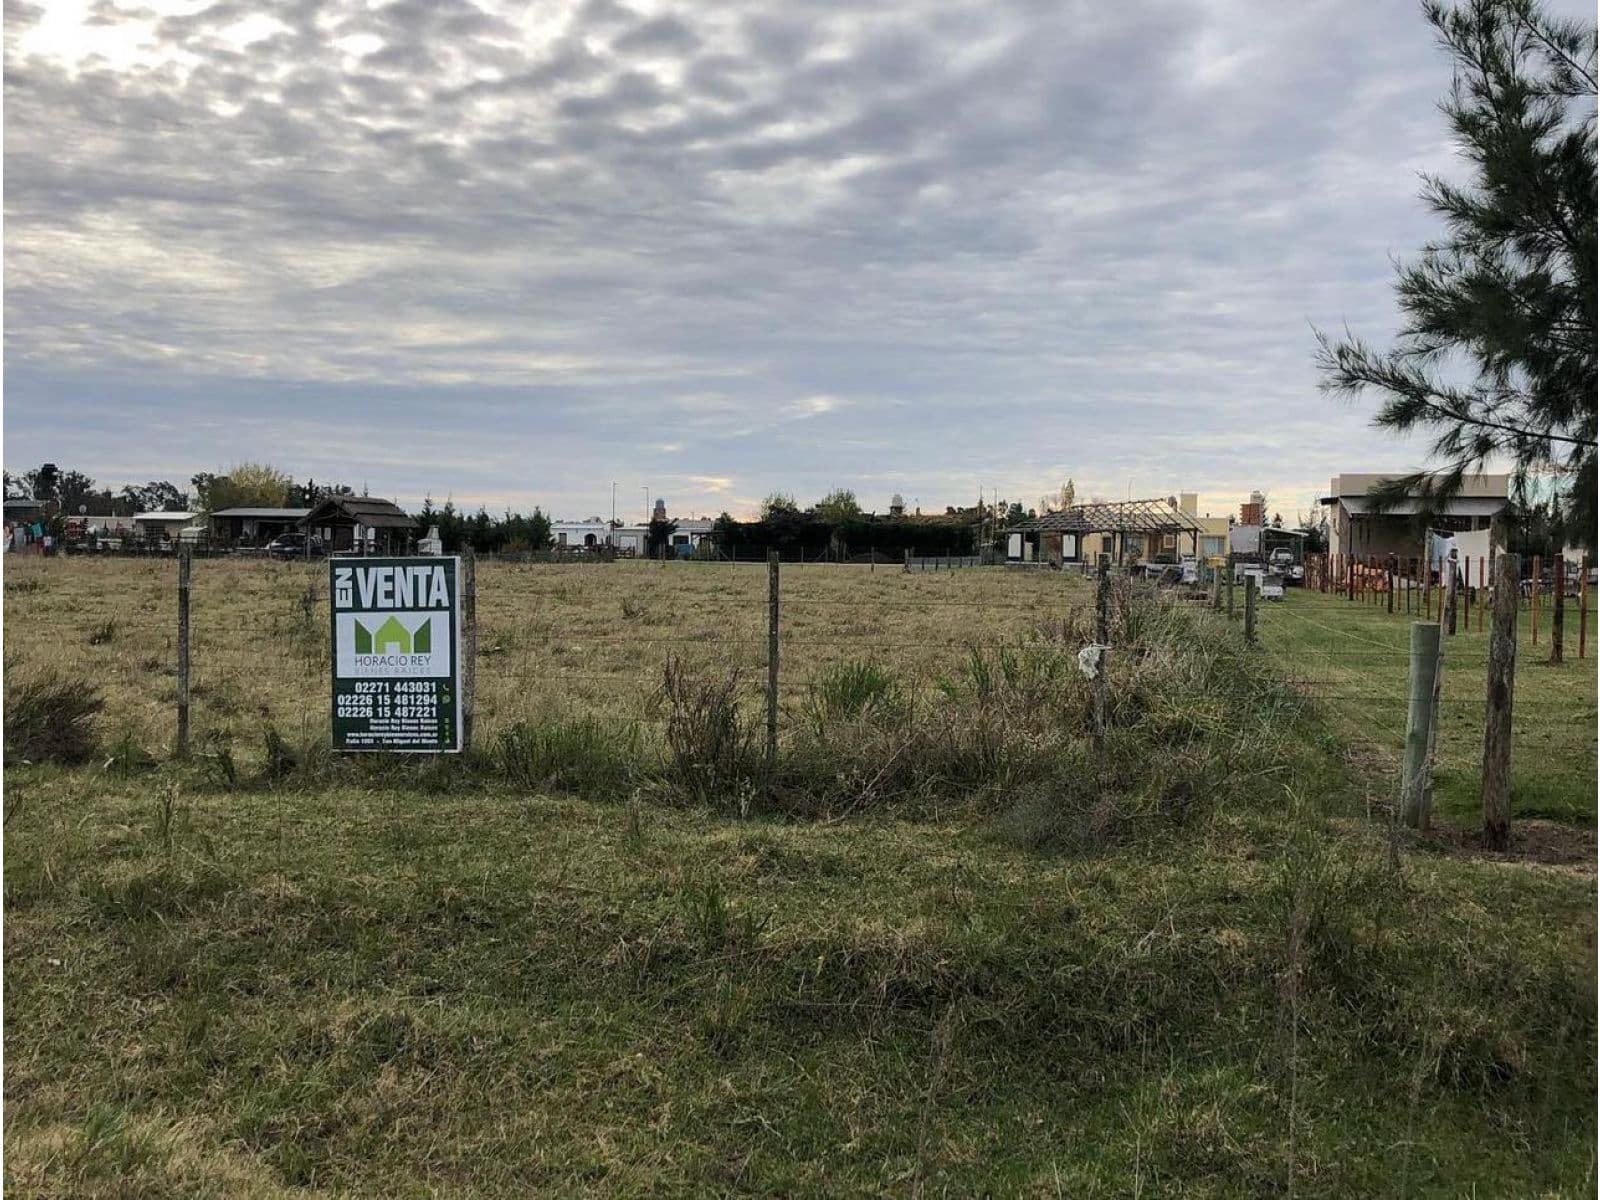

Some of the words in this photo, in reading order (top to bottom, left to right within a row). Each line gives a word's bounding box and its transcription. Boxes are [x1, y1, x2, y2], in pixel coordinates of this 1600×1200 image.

[336, 567, 353, 608] EN
[355, 566, 450, 608] VENTA
[355, 656, 408, 666] HORACIO
[411, 656, 432, 666] REY
[355, 682, 390, 693] 02271
[394, 682, 437, 693] 443031
[337, 694, 373, 706] 02226
[377, 694, 391, 706] 15
[394, 694, 438, 706] 481294
[337, 706, 373, 718] 02226
[377, 706, 391, 718] 15
[394, 706, 437, 718] 487221
